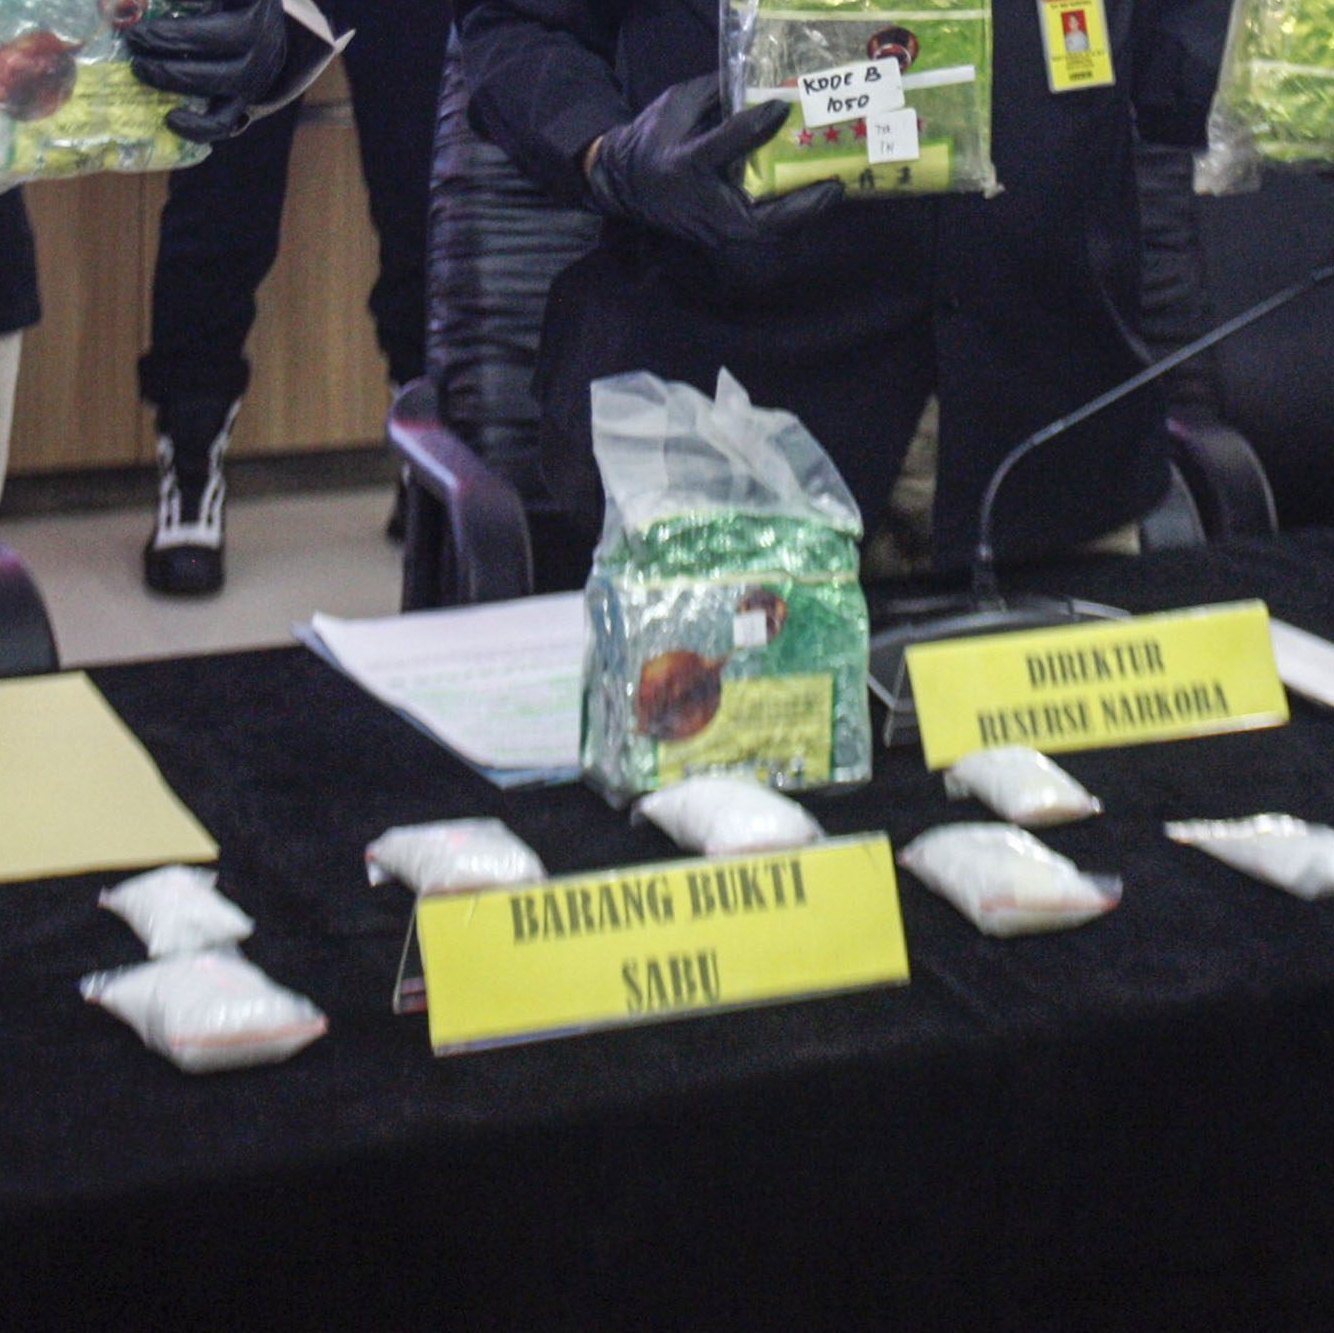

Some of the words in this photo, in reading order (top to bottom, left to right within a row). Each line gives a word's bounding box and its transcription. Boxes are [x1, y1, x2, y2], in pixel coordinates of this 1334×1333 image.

[864, 66, 882, 83] B
[827, 94, 871, 114] 1050
[1026, 639, 1165, 688] DIREKTUR
[977, 699, 1090, 747] RESERSE
[1099, 679, 1230, 728] NARKOBA
[509, 874, 676, 944] BARANG
[686, 860, 807, 916] BUKTI
[620, 950, 721, 1015] SABU
